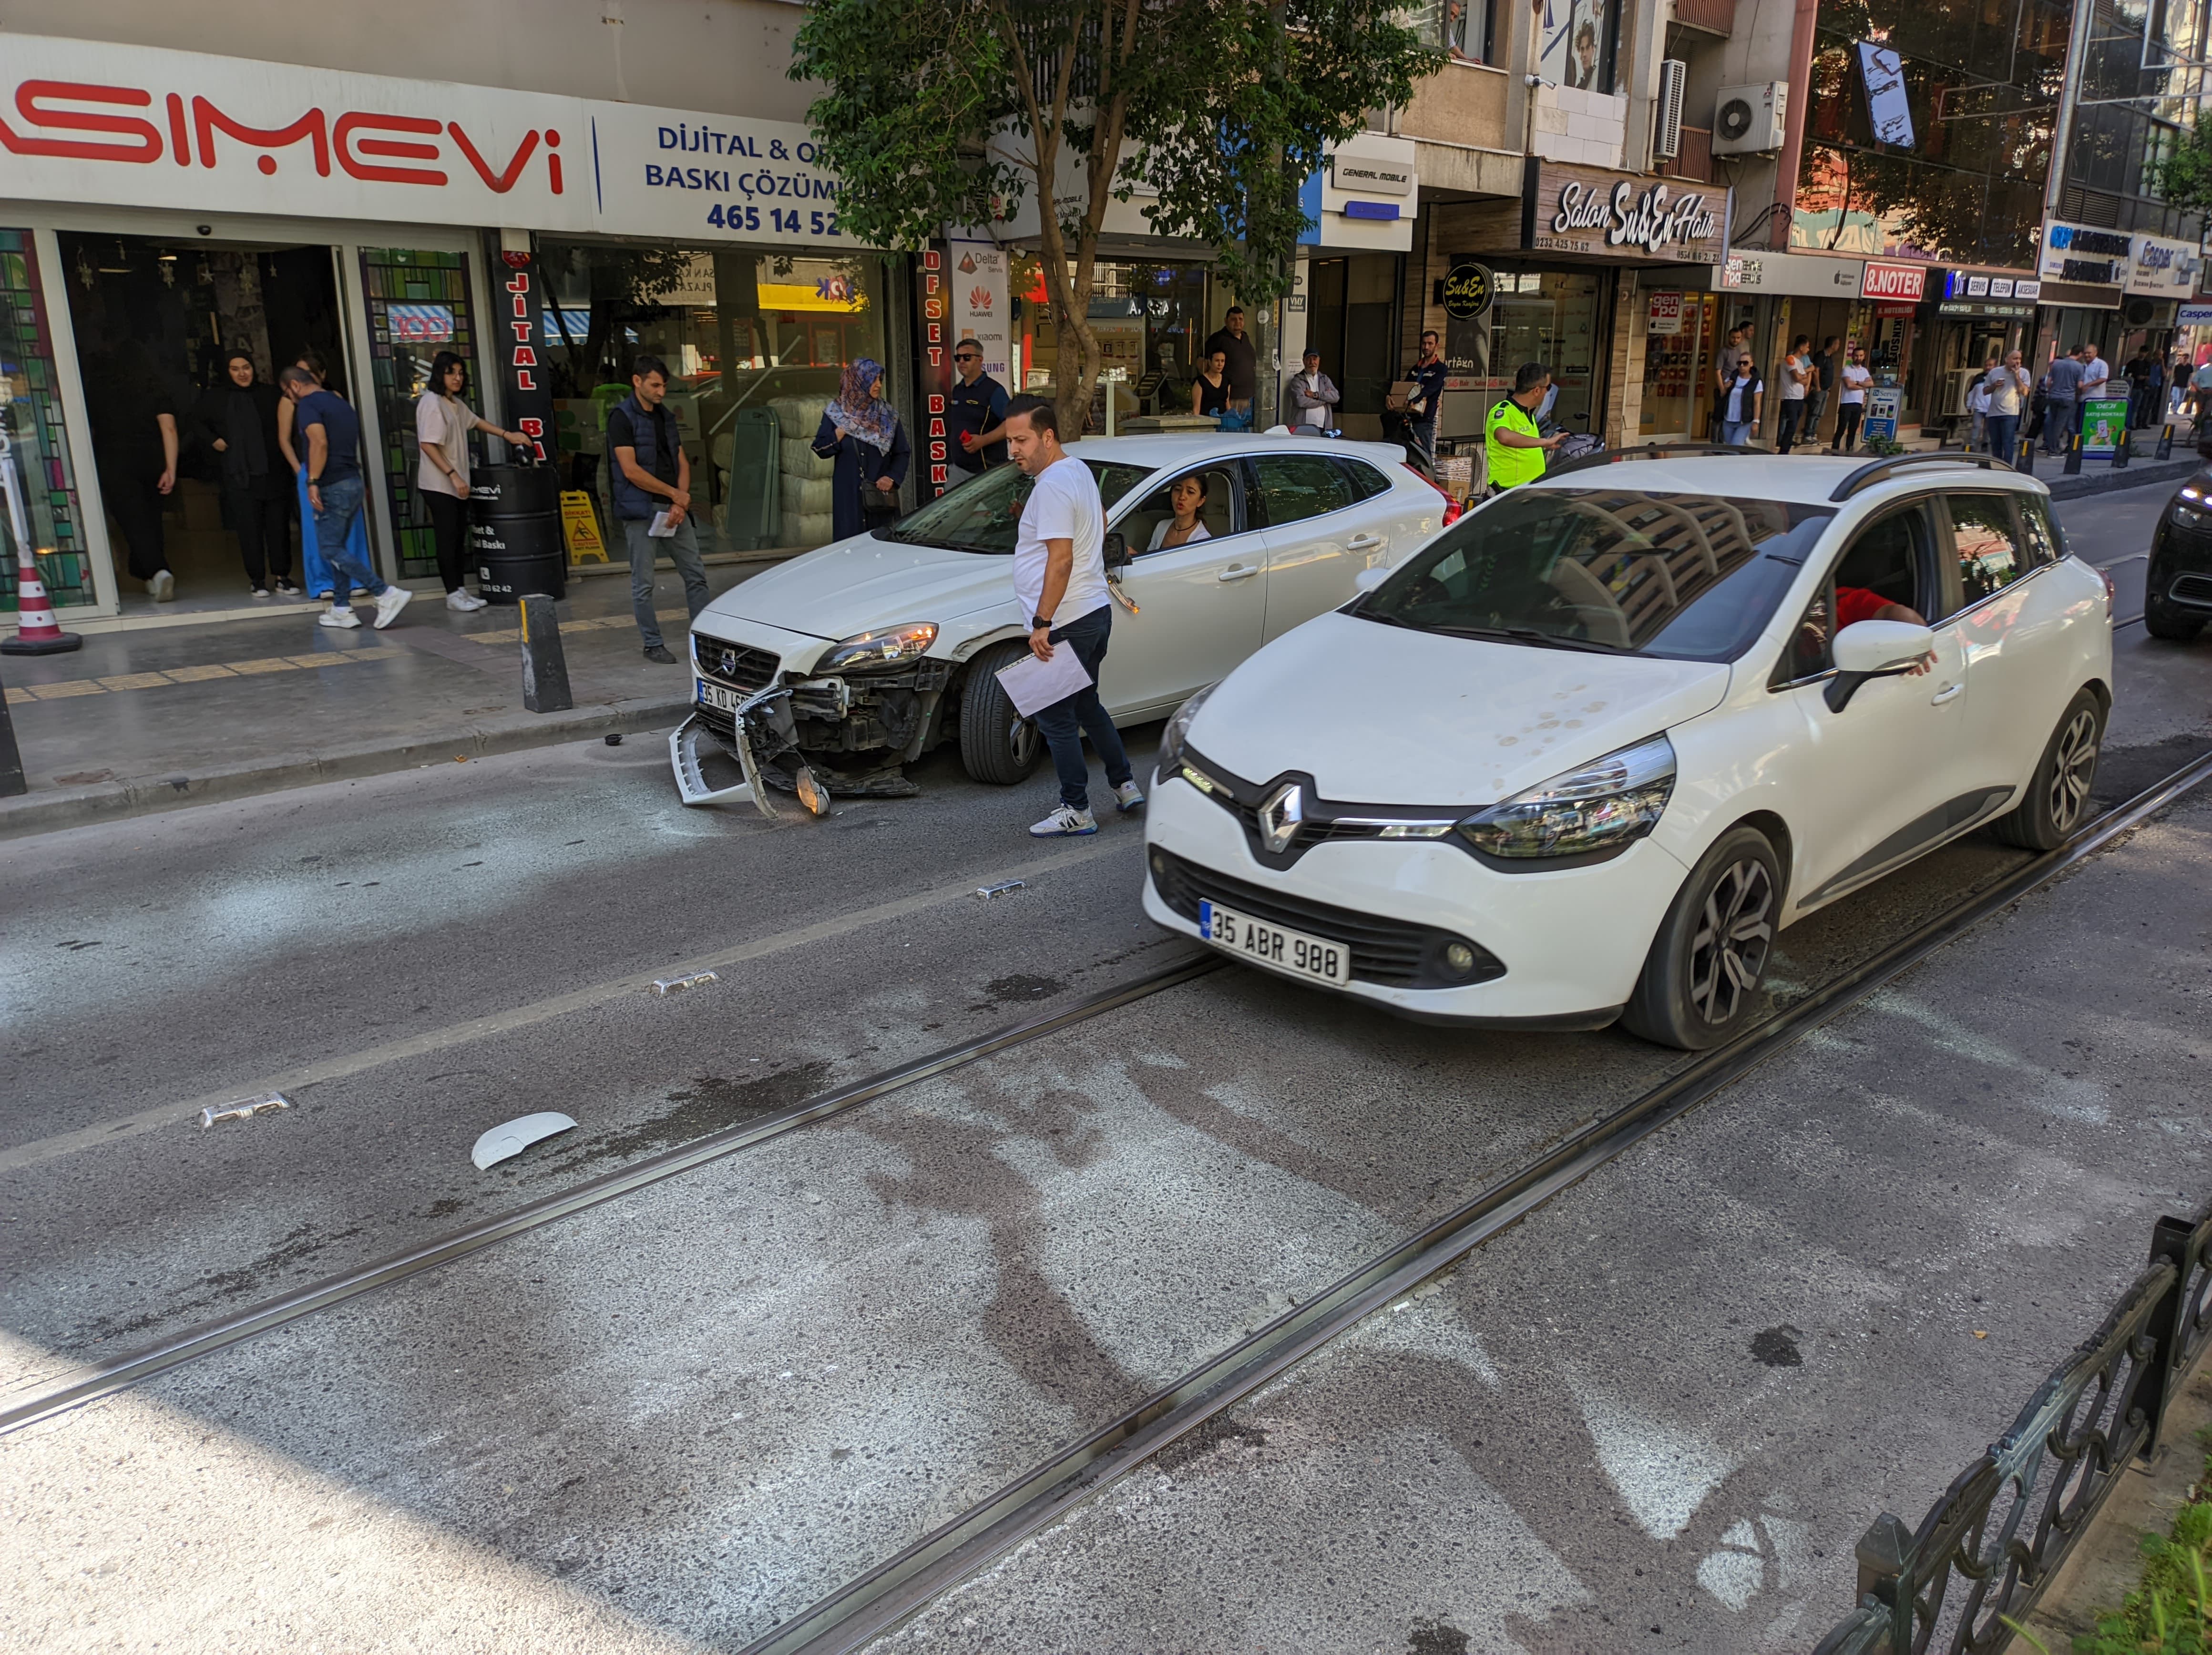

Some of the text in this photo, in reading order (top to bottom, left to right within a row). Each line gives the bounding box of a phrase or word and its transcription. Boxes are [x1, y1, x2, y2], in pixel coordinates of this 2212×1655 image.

[657, 123, 763, 158] DİJİTAL
[769, 139, 790, 161] &
[645, 164, 730, 192] BASKI
[1342, 168, 1407, 183] GENERAL MOBILE
[707, 204, 842, 236] 465 14 52
[1554, 182, 1715, 253] Salon Su&En Hair
[1535, 237, 1589, 252] 0232 425 75 62
[975, 253, 998, 264] Delta
[1725, 258, 1743, 275] gen
[1445, 276, 1485, 297] Su&En
[1729, 271, 1741, 286] pa
[1866, 268, 1922, 295] 8.NOTER
[923, 250, 942, 367] OFSET
[1290, 297, 1304, 306] VMY
[1653, 296, 1679, 308] gen
[1659, 306, 1678, 317] pa
[2180, 309, 2212, 320] Casper
[506, 273, 538, 390] JİTAL
[982, 362, 1005, 373] SUNG
[703, 684, 713, 704] 35
[1212, 911, 1338, 978] 35 ABR 988
